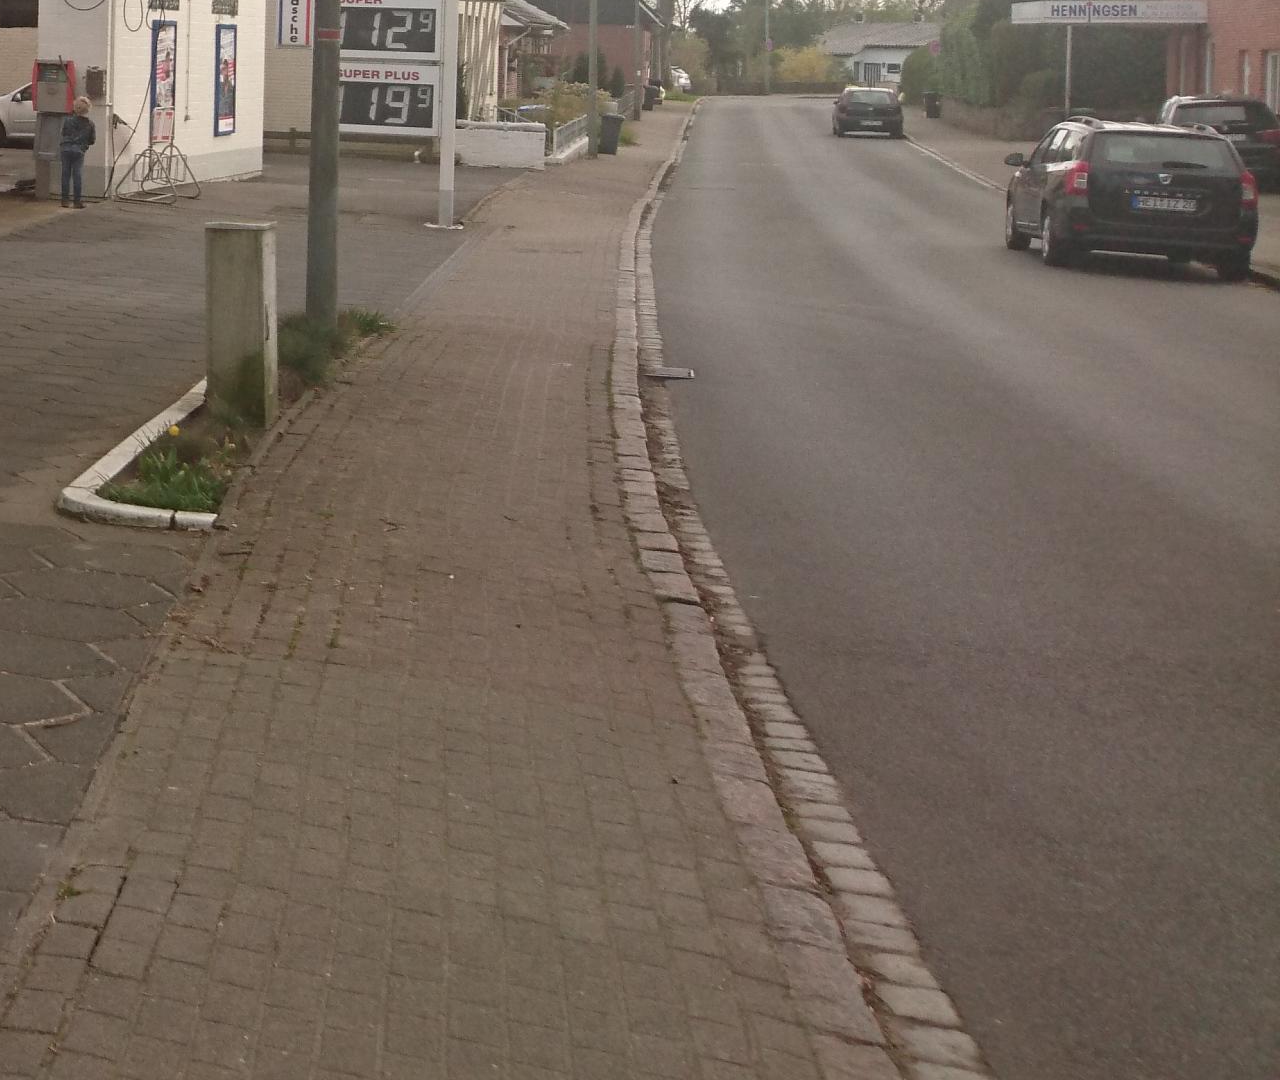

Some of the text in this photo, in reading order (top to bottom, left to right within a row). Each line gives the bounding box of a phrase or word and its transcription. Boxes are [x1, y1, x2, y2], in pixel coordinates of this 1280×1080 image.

[1051, 3, 1138, 17] HENNINGSEN
[339, 69, 420, 81] SUPER PLUS
